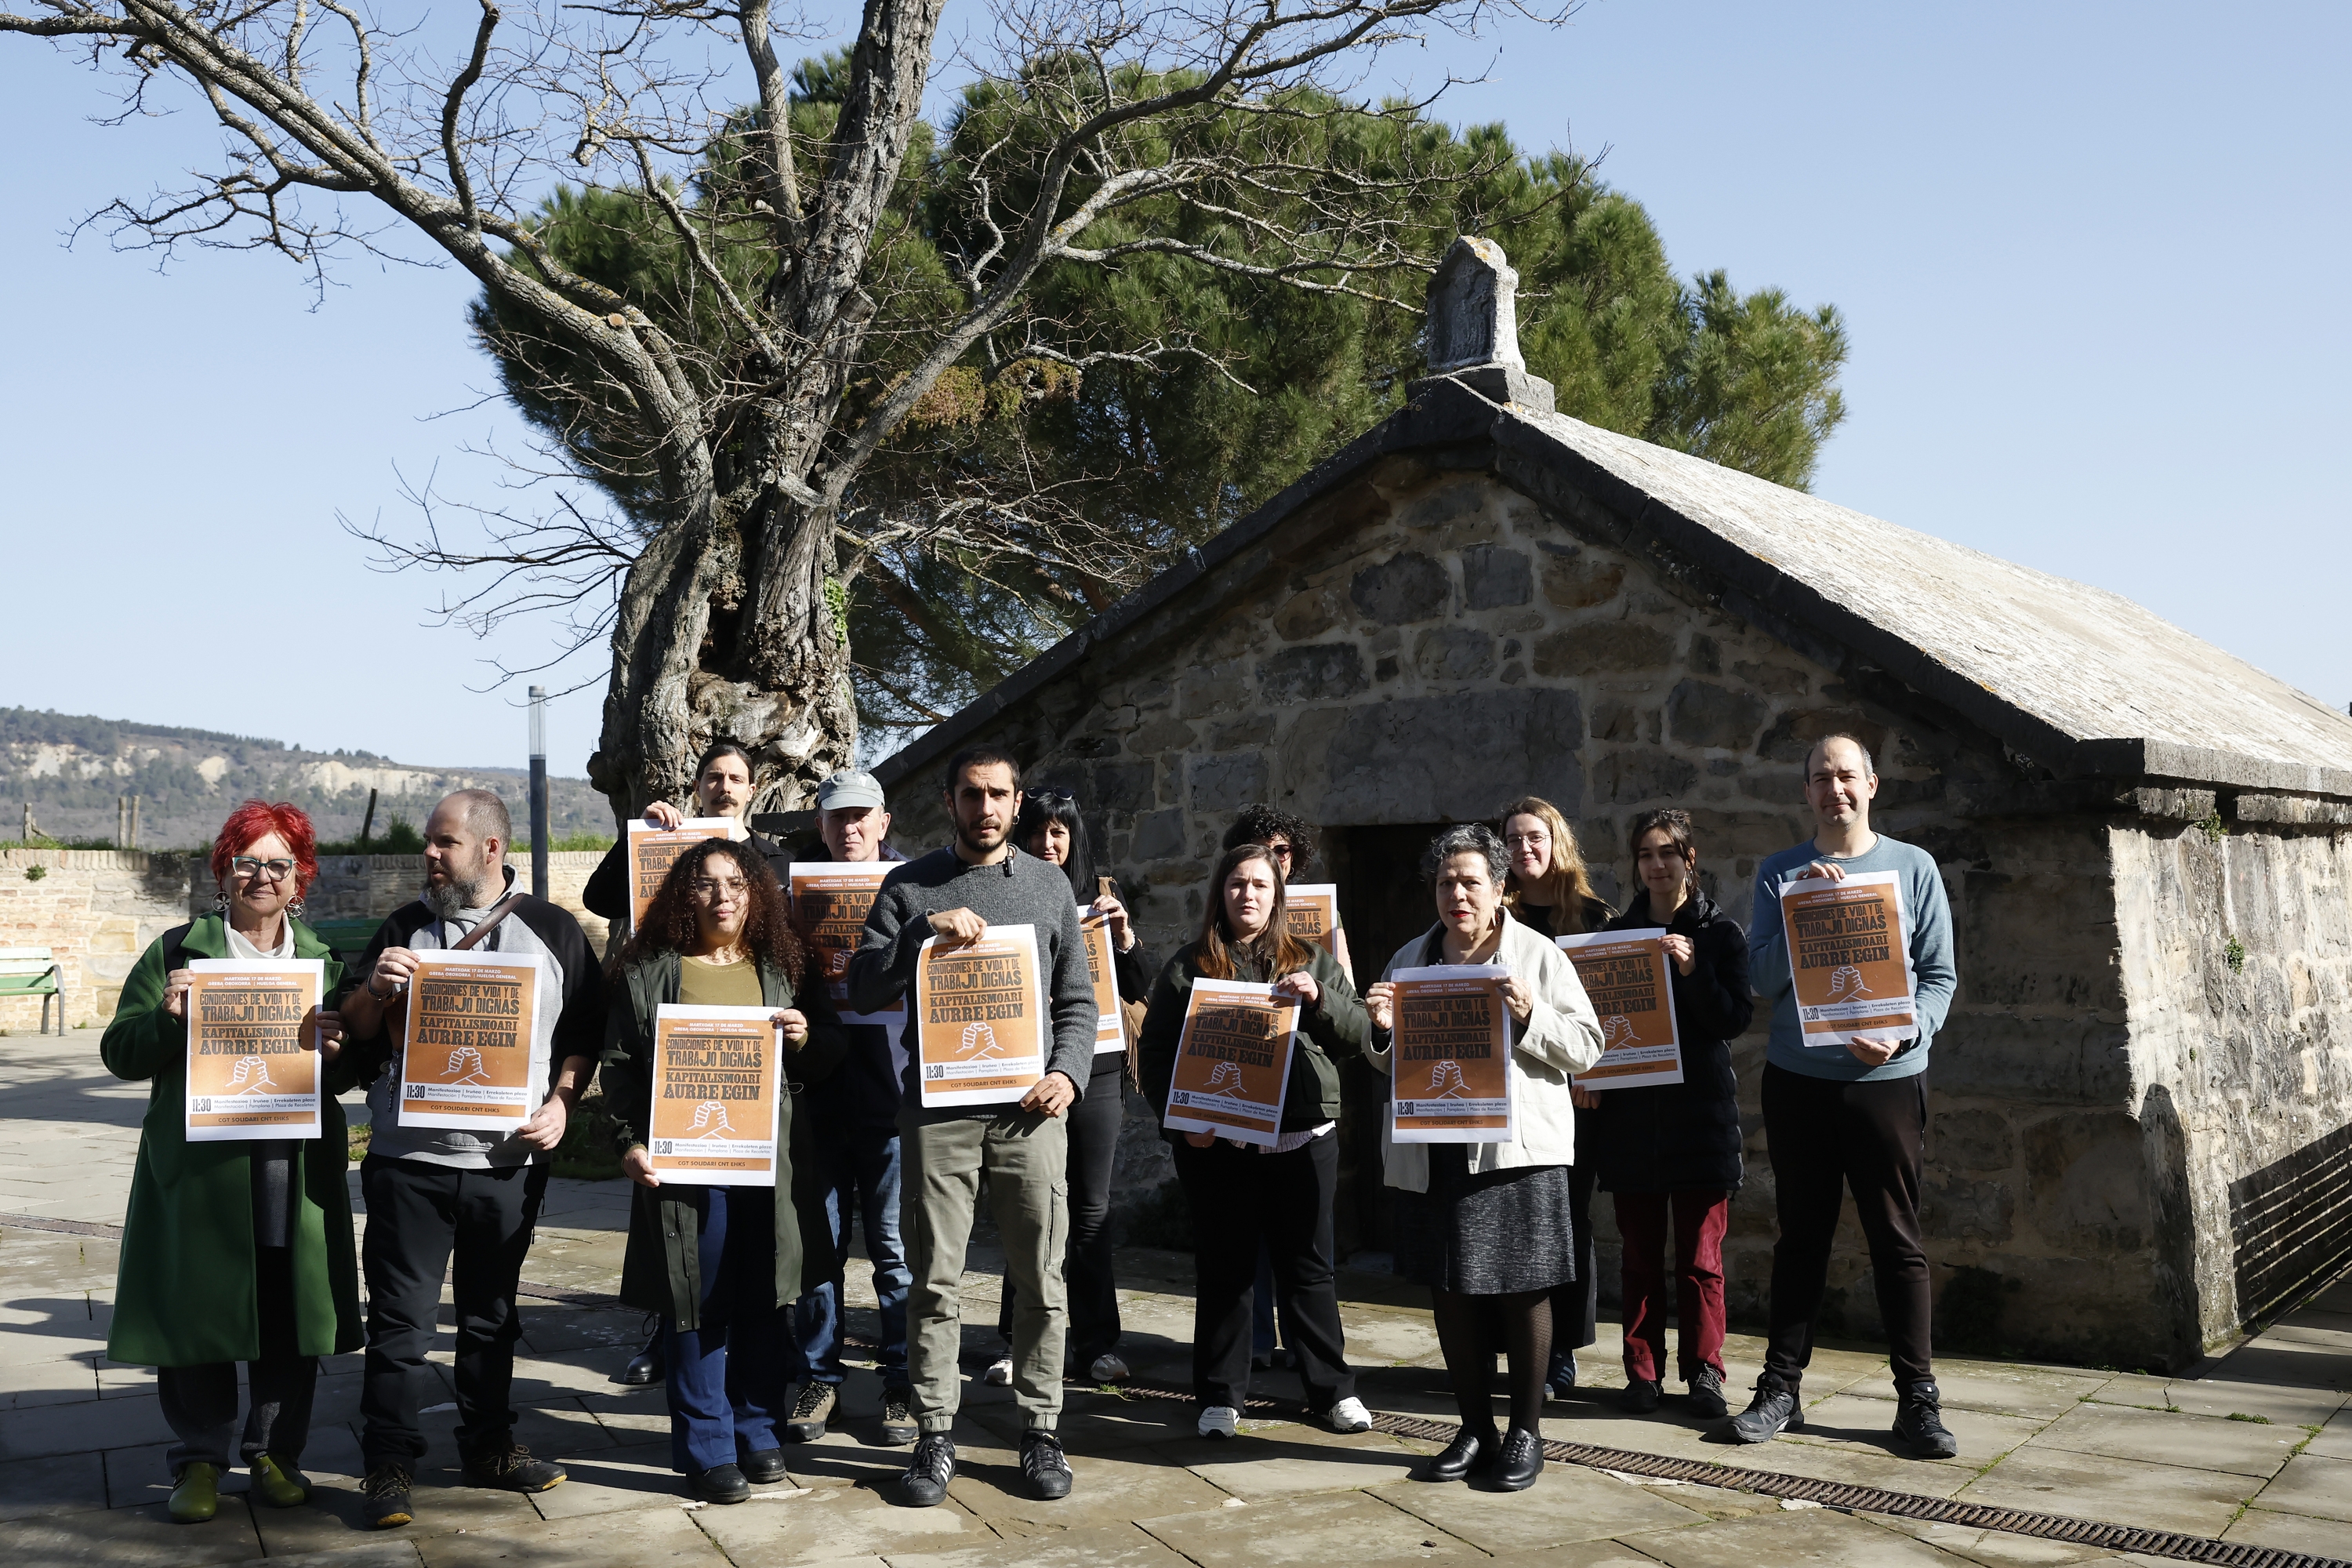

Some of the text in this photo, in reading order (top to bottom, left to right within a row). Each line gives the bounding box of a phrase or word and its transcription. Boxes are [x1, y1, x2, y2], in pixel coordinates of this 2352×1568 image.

[638, 847, 675, 857] CONDICIONES
[843, 894, 871, 904] DE VIDA
[1291, 912, 1320, 921] VIDA Y DE
[1793, 903, 1884, 924] CONDICIONES DE VIDA Y DE
[1288, 922, 1321, 934] DIGNAS
[1795, 914, 1887, 939] TRABAJO DIGNAS
[1087, 934, 1094, 942] DE
[1798, 935, 1888, 954] KAPITALISMOARI
[1800, 946, 1890, 970] AURRE EGIN
[927, 958, 1020, 976] CONDICIONES DE VIDA Y DE
[928, 970, 1022, 992] TRABAJO DIGNAS
[1616, 968, 1654, 985] DIGNAS
[200, 993, 301, 1006] CONDICIONES DE VIDA Y DE
[420, 983, 519, 999] CONDICIONES DE VIDA Y DE
[930, 991, 1022, 1008] KAPITALISMOARI
[201, 1005, 302, 1022] TRABAJO DIGNAS
[420, 995, 520, 1015] TRABAJO DIGNAS
[929, 1003, 1023, 1024] AURRE EGIN
[1622, 997, 1657, 1014] EGIN
[1402, 1010, 1490, 1029] TRABAJO DIGNAS
[1802, 1007, 1819, 1021] 11:30
[419, 1017, 517, 1031] KAPITALISMOARI
[1193, 1016, 1279, 1039] TRABAJO DIGNAS
[199, 1037, 302, 1056] AURRE EGIN
[416, 1028, 517, 1048] AURRE EGIN
[666, 1038, 761, 1052] CONDICIONES DE VIDA Y DE
[1191, 1033, 1275, 1054] KAPITALISMOARI
[666, 1051, 762, 1068] TRABAJO DIGNAS
[1187, 1042, 1274, 1068] AURRE EGIN
[1402, 1043, 1491, 1061] AURRE EGIN
[666, 1072, 760, 1084] KAPITALISMOARI
[926, 1065, 944, 1079] 11:30
[407, 1085, 425, 1099] 11:30
[663, 1084, 760, 1101] AURRE EGIN
[1173, 1091, 1190, 1105] 11:30
[192, 1098, 211, 1112] 11:30
[1397, 1102, 1414, 1115] 11:30
[654, 1140, 673, 1155] 11:30
